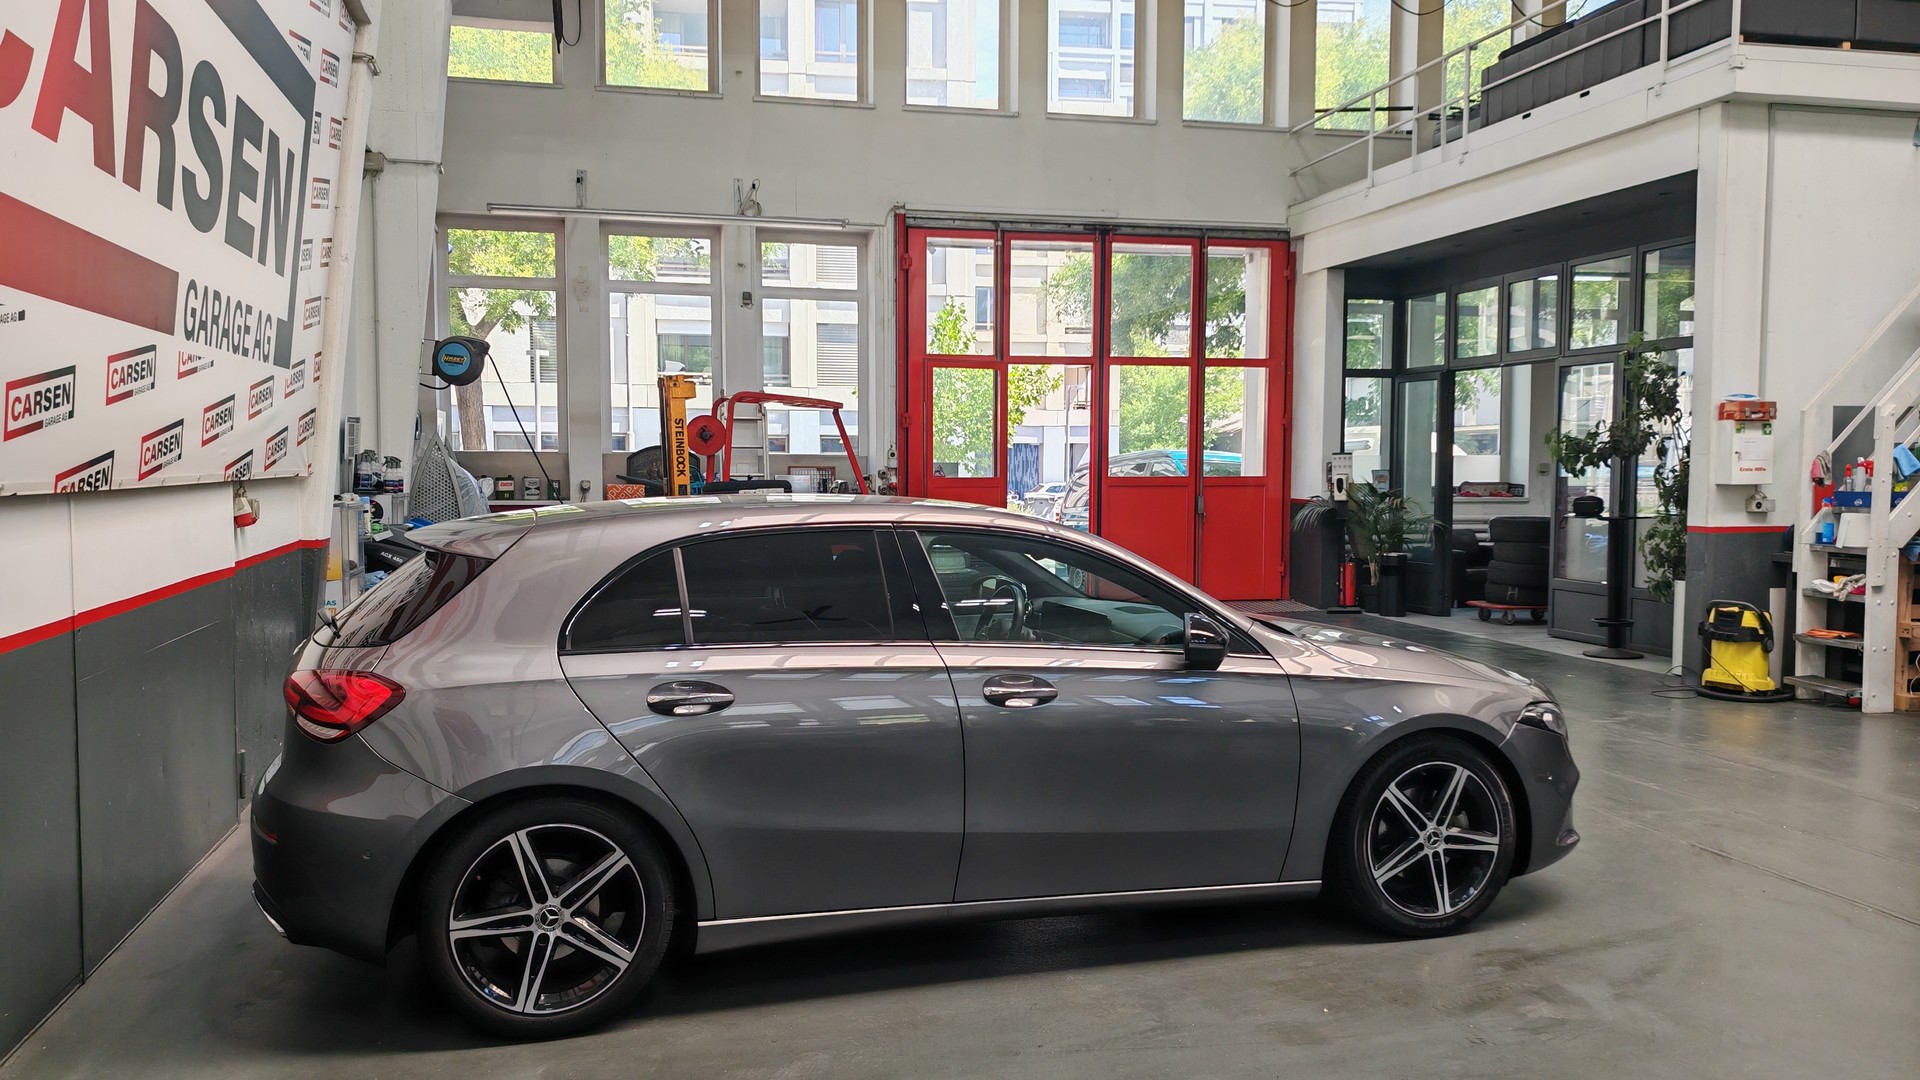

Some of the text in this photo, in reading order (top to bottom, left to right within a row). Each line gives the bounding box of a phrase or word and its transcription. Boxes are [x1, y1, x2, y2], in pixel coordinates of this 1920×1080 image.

[0, 0, 295, 278] ARSEN
[184, 279, 272, 363] GARAGE AG
[111, 358, 153, 390] CARSEN
[11, 382, 71, 422] CARSEN
[251, 386, 272, 409] CARSEN
[205, 406, 233, 434] CARSEN
[144, 431, 180, 466] CARSEN
[674, 418, 686, 477] STEINBOCK
